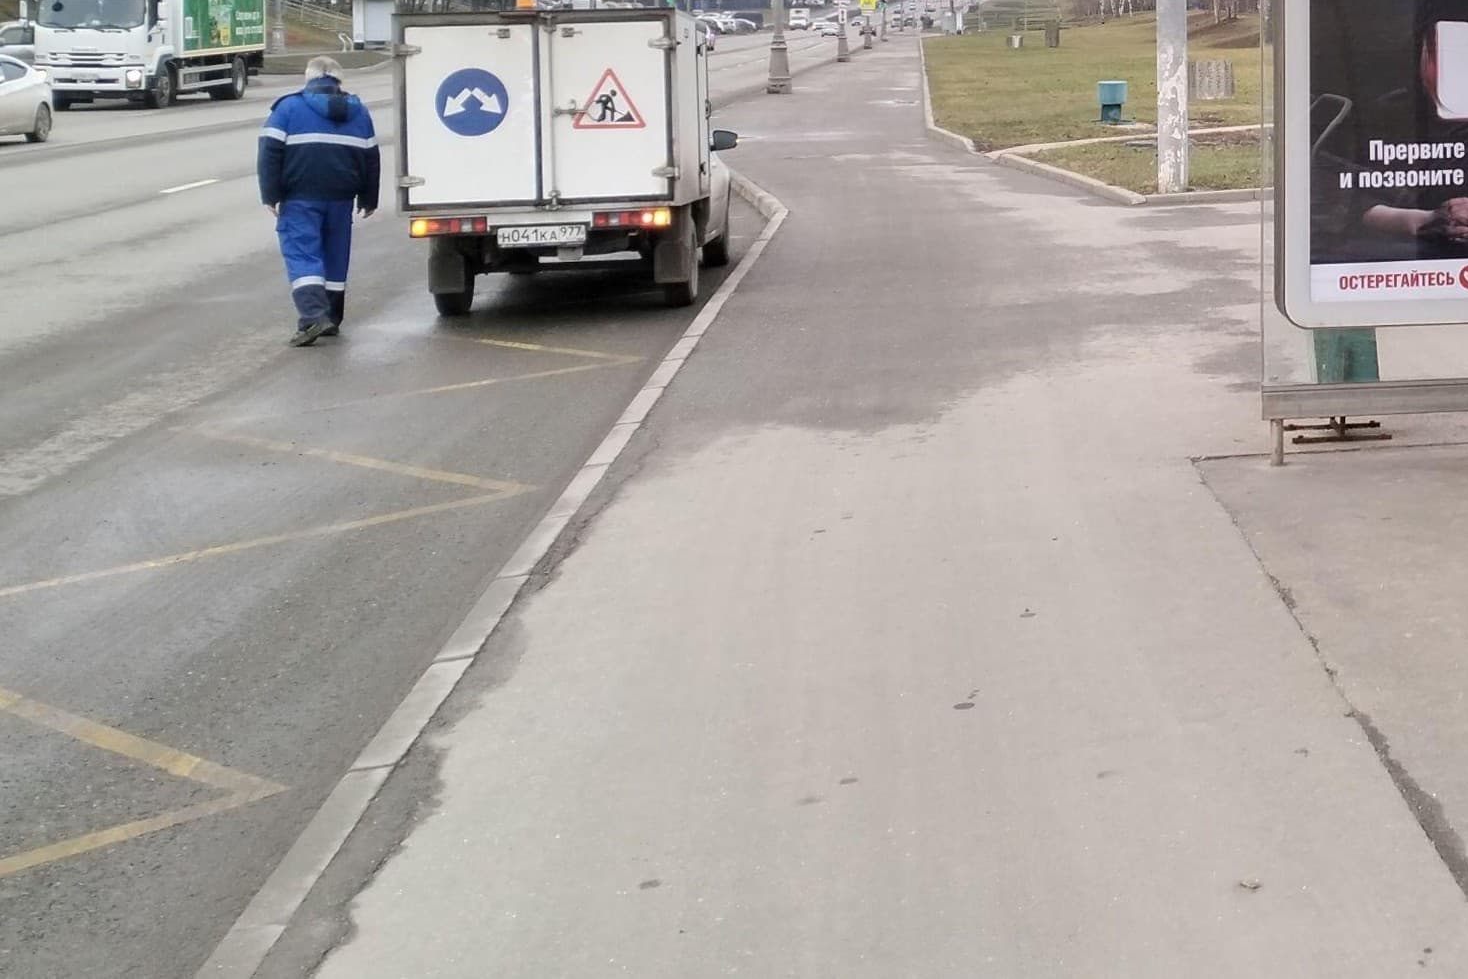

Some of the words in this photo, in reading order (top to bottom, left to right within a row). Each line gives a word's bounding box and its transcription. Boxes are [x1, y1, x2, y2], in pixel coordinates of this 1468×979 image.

[1369, 140, 1465, 165] Прервите
[1340, 172, 1353, 189] и
[1358, 168, 1465, 188] позвоните
[1339, 270, 1455, 290] ОСТЕРЕГАЙТЕСЬ
